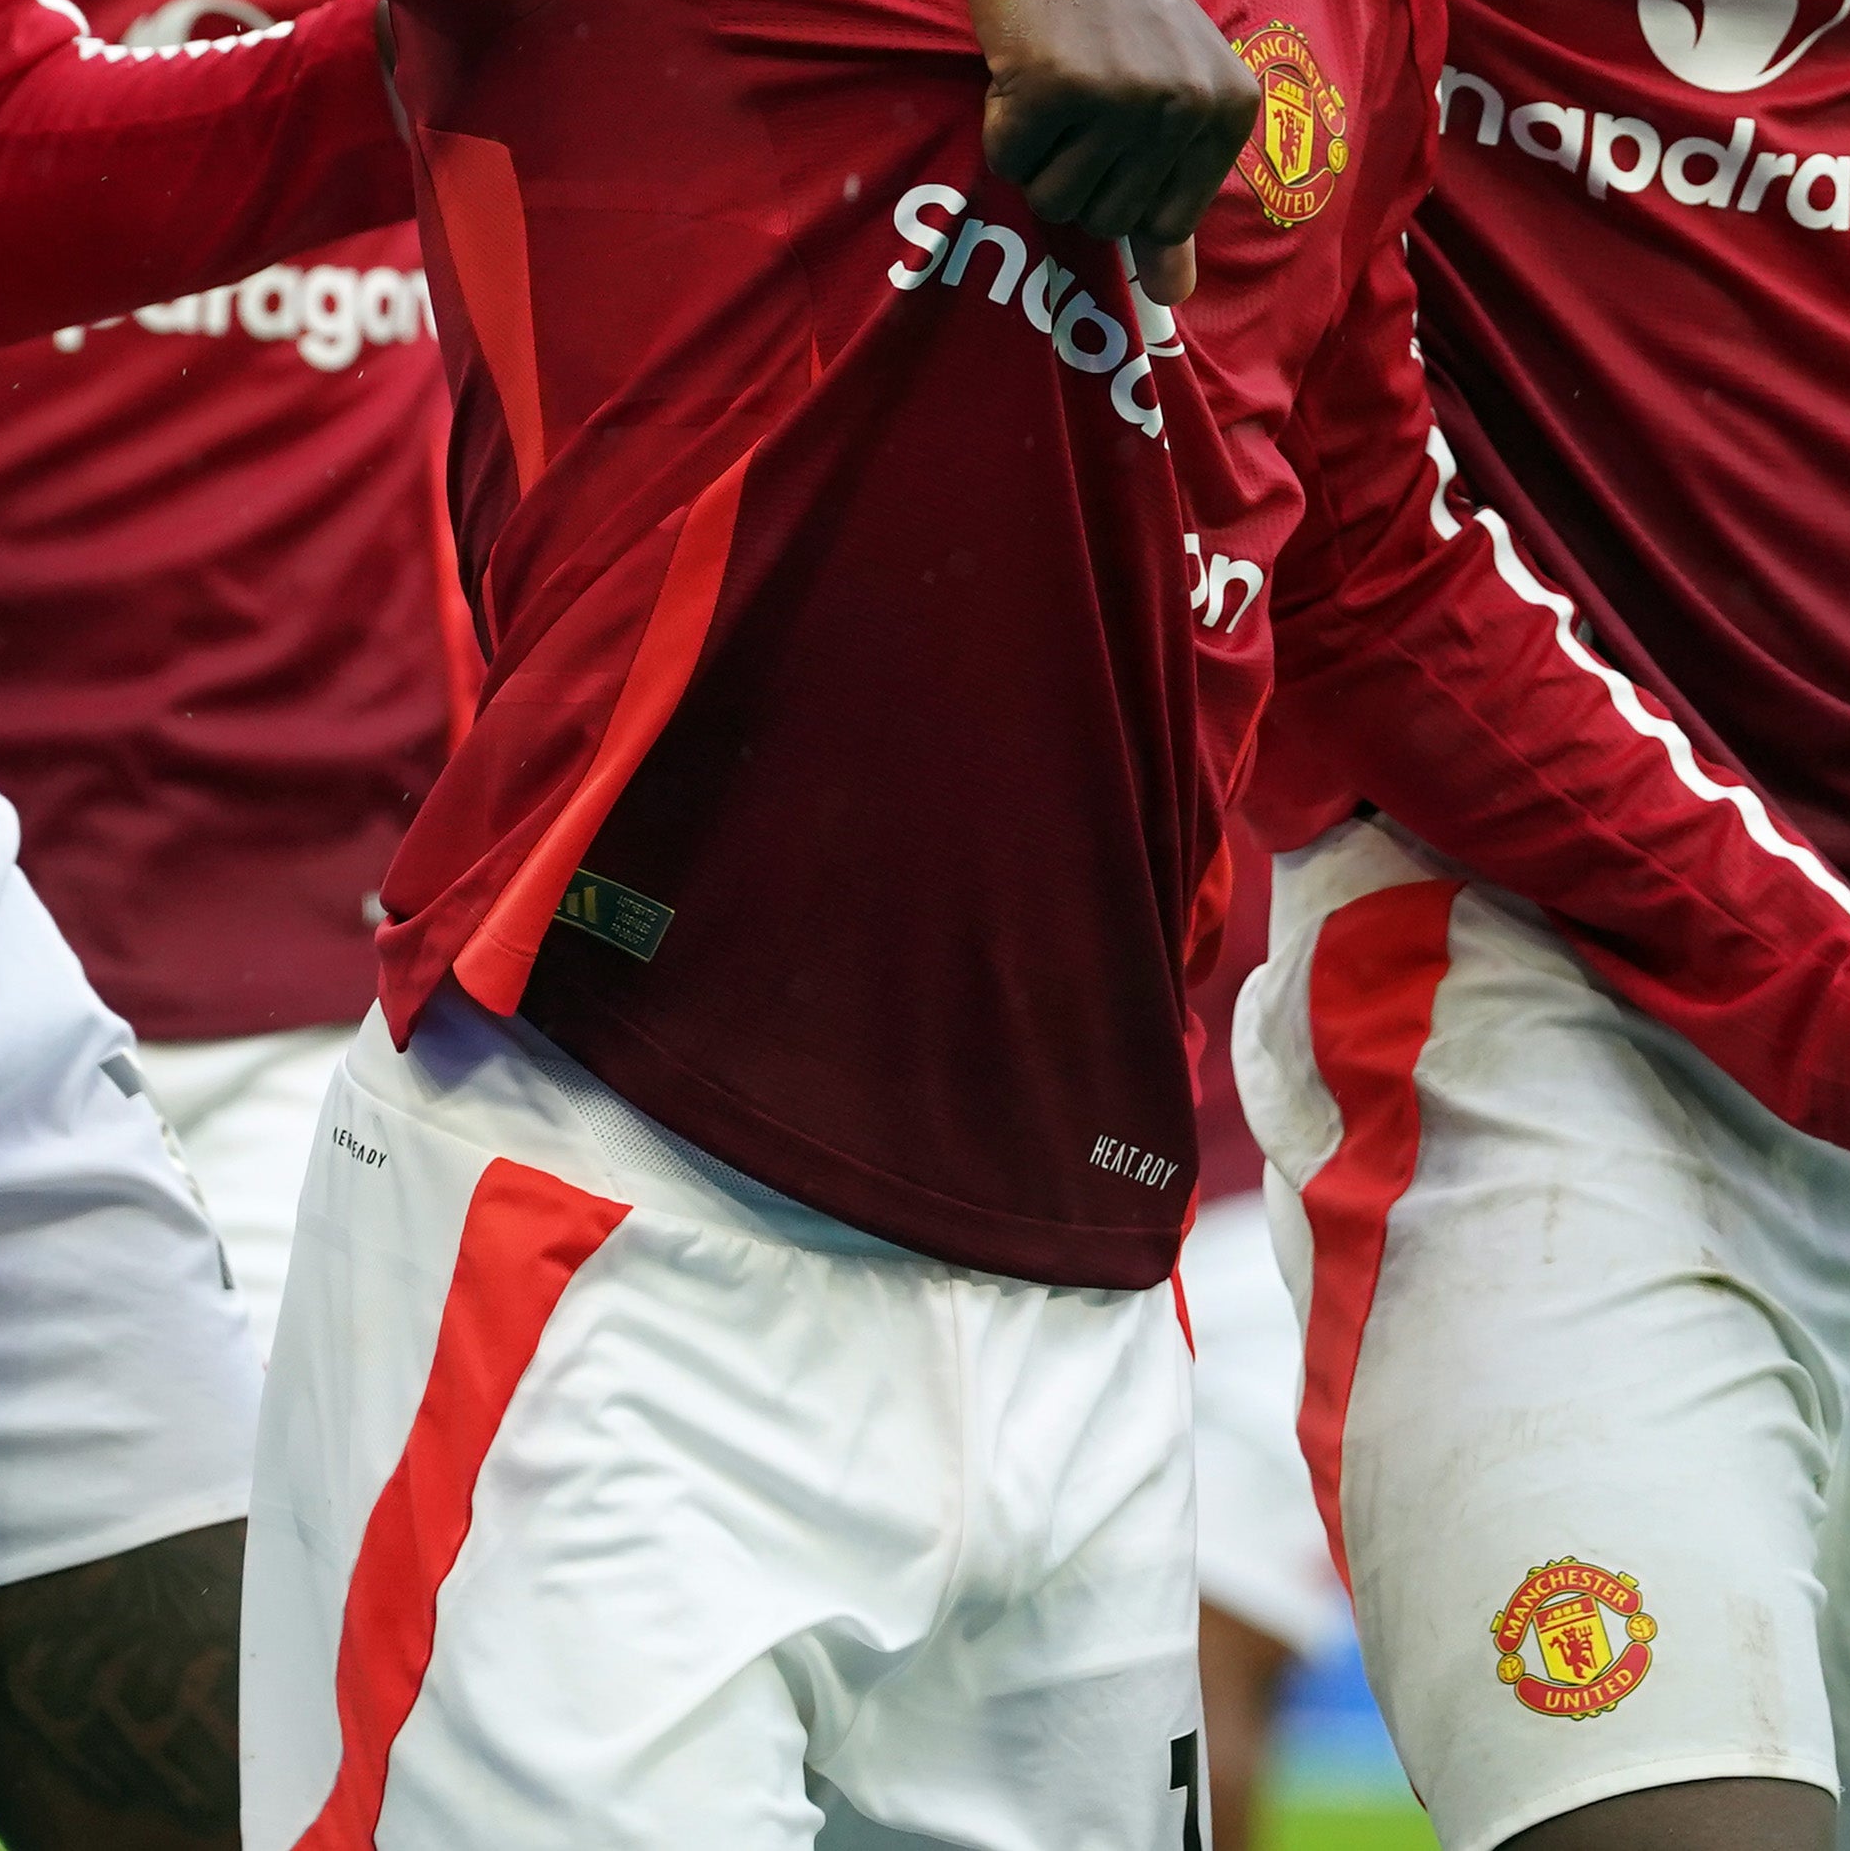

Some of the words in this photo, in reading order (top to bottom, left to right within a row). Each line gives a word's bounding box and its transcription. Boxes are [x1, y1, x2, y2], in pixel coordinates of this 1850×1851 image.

[1253, 162, 1316, 214] UNITED
[1089, 1134, 1179, 1191] HEAT.RDY
[1503, 1570, 1630, 1640] MANCHESTER
[1545, 1668, 1633, 1709] UNITED
